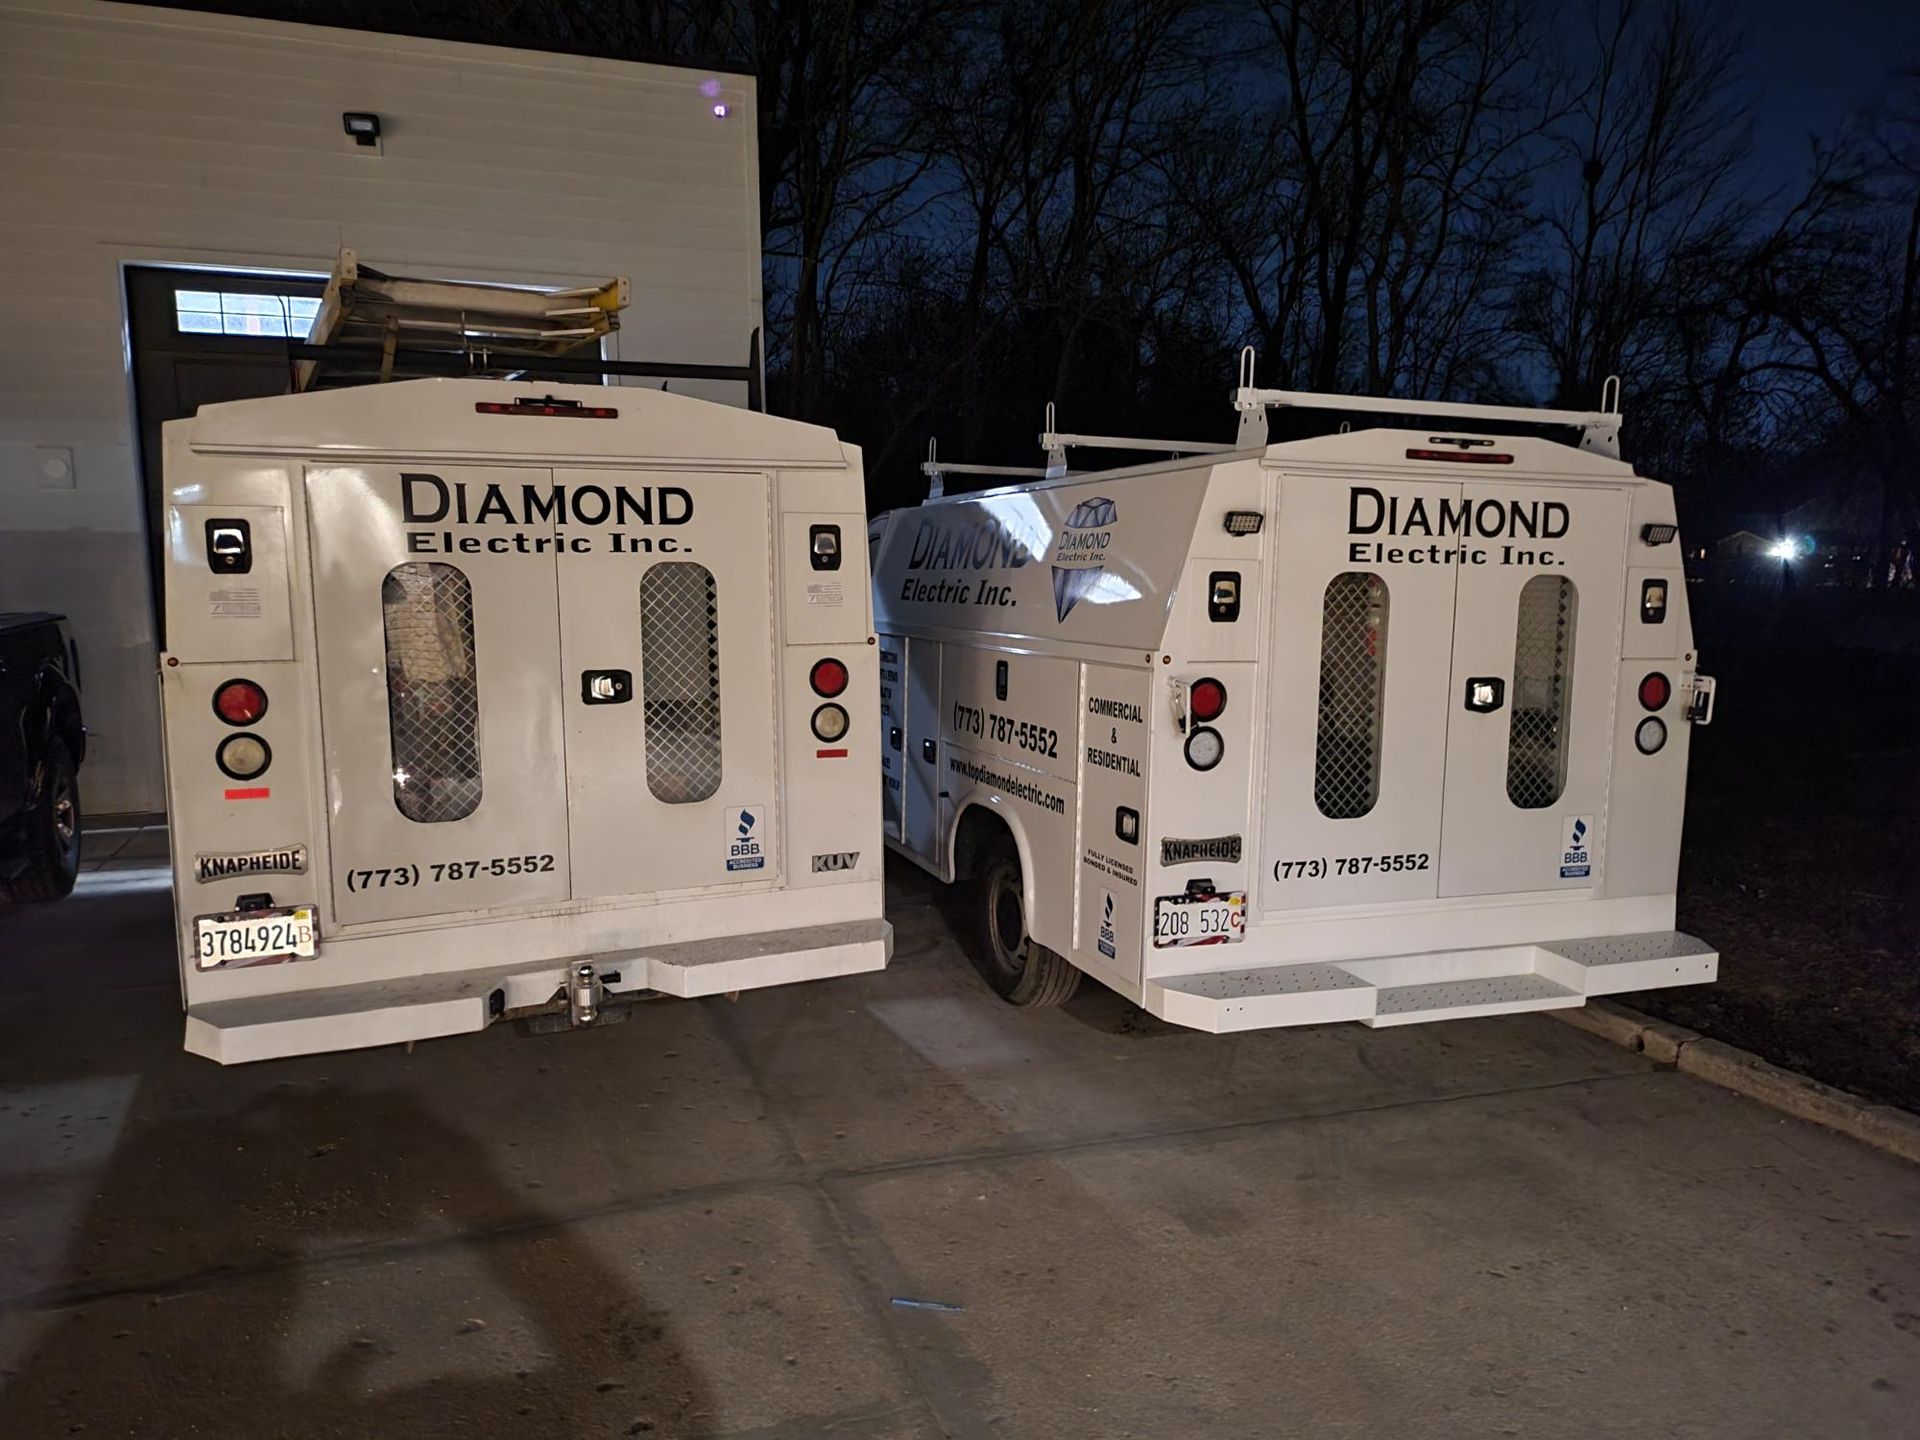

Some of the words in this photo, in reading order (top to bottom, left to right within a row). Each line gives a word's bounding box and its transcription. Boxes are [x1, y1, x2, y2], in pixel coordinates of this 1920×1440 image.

[399, 472, 694, 527] DIAMOND
[1348, 486, 1570, 539] DIAMOND
[407, 531, 592, 555] Electric
[608, 532, 693, 554] Inc.
[1058, 530, 1111, 550] DIAMOND
[1056, 552, 1088, 562] Electric
[1089, 551, 1107, 562] Inc.
[1349, 542, 1488, 565] Electric
[1500, 544, 1566, 566] Inc.
[900, 578, 970, 606] Electric
[974, 579, 1018, 607] Inc.
[1088, 696, 1143, 723] COMMERCIAL
[953, 701, 985, 740] (773)
[989, 713, 1058, 759] 787-5552
[1110, 727, 1118, 744] &
[1087, 747, 1141, 777] RESIDENTIAL
[949, 757, 1065, 815] www.topdiamondelectric.com
[731, 843, 760, 856] BBB
[811, 851, 860, 873] KUV
[1088, 849, 1105, 862] FULLY
[1105, 856, 1134, 875] LICENSED
[1163, 840, 1239, 862] KNAPHEIDE
[1564, 852, 1588, 863] BBB
[200, 850, 302, 879] KNAPHEIDE
[346, 864, 421, 893] (773)
[430, 854, 555, 883] 787-5552
[1083, 856, 1106, 871] BONDED
[1112, 869, 1138, 887] INSURED
[1273, 857, 1328, 882] (773)
[1335, 853, 1430, 876] 787-5552
[1100, 926, 1115, 943] BBB
[1160, 911, 1189, 936] 208
